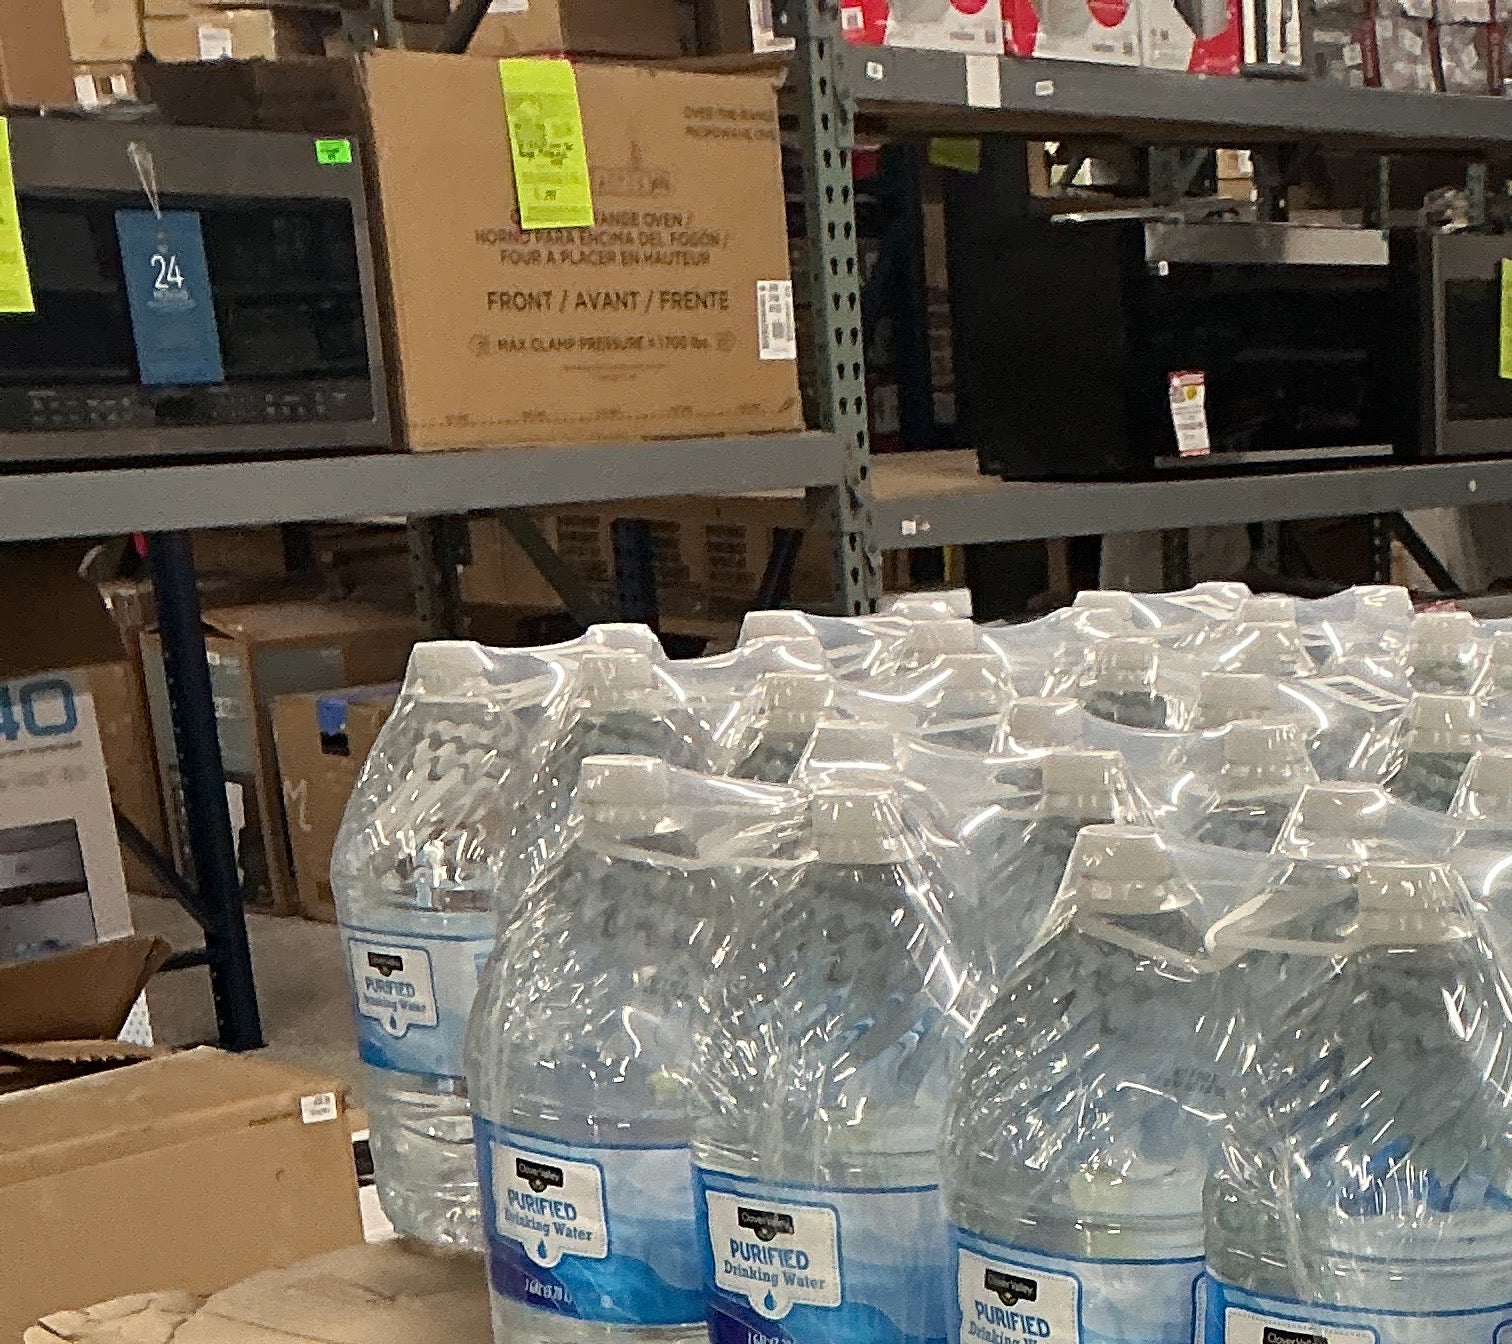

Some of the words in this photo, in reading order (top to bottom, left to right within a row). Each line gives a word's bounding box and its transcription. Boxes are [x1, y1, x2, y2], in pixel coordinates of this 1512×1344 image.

[150, 253, 184, 289] 24
[487, 291, 553, 312] FRONT
[574, 291, 641, 312] AVANT
[659, 290, 730, 311] FRENTE
[507, 1189, 577, 1221] PURIFIED
[505, 1210, 551, 1237] Drinking
[553, 1220, 593, 1242] Water
[729, 1238, 809, 1270] PURIFIED
[724, 1260, 778, 1287] Drinking
[781, 1268, 826, 1291] Water
[974, 1300, 1051, 1338] PURIFIED
